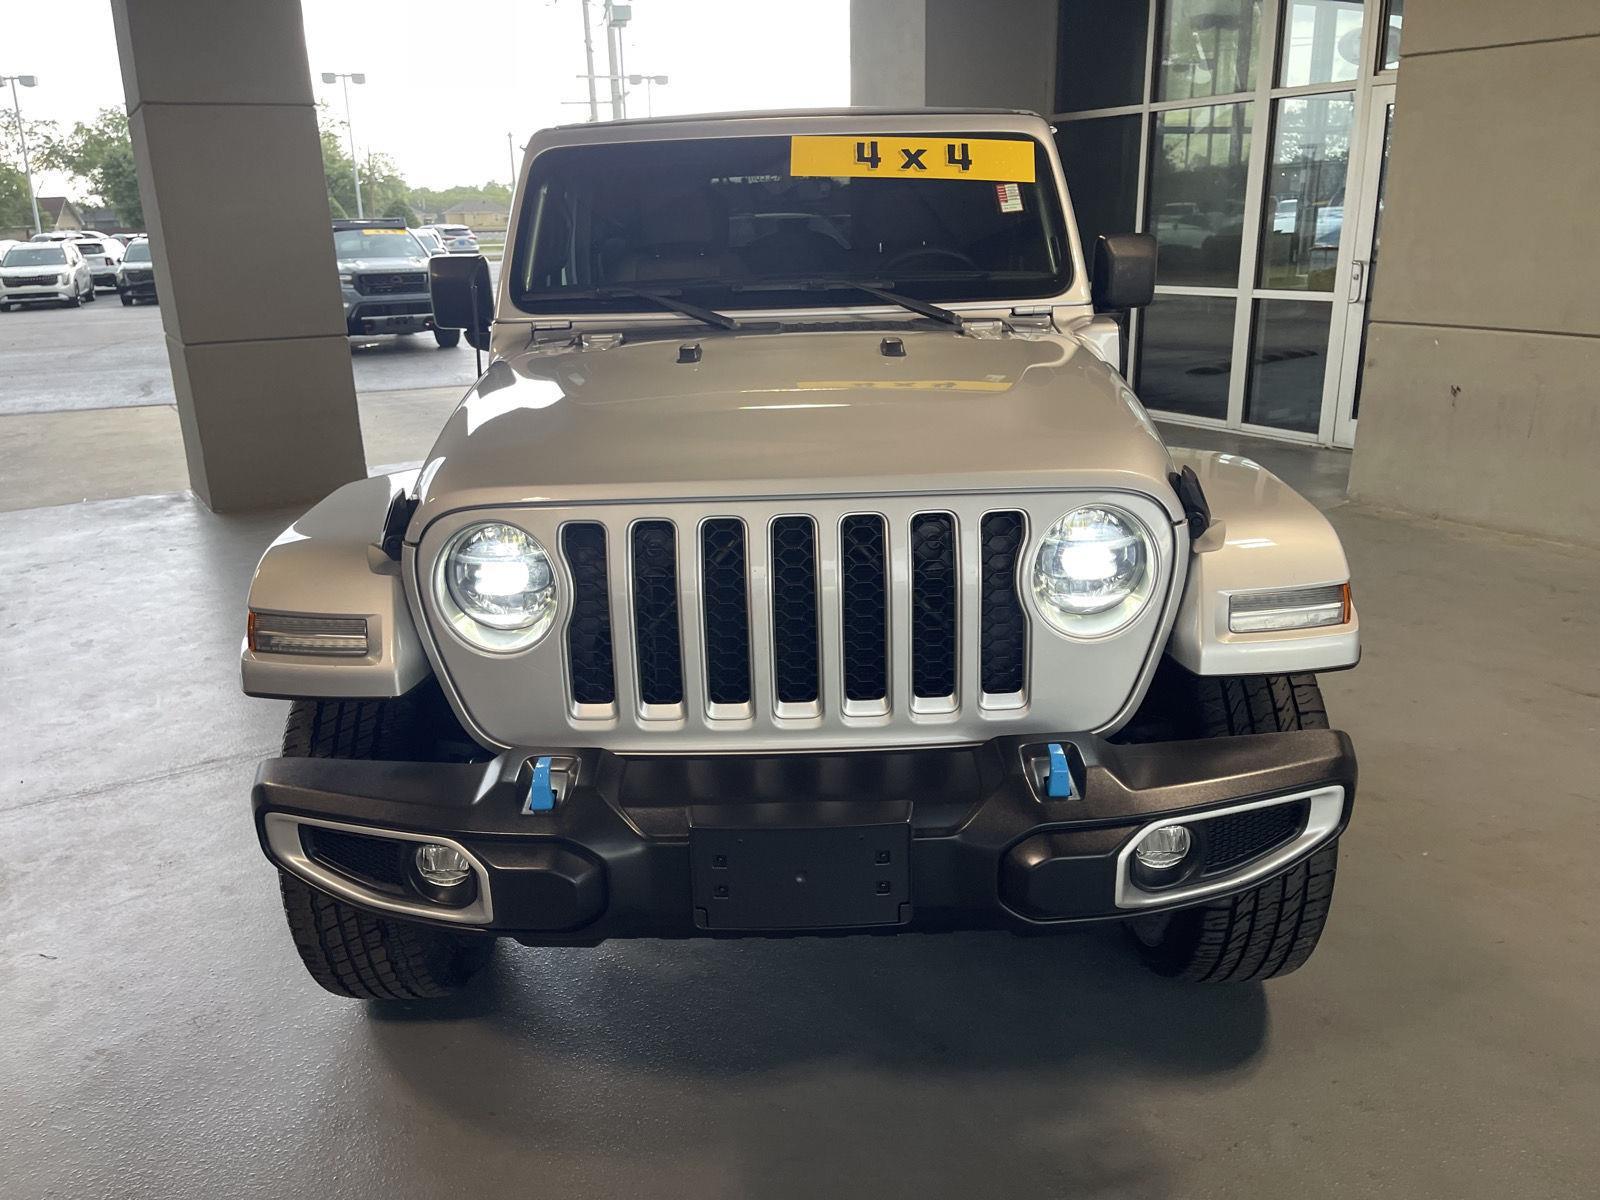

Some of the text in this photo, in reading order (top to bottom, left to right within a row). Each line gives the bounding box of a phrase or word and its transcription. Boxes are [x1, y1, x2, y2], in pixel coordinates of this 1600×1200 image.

[856, 141, 972, 171] 4 x 4
